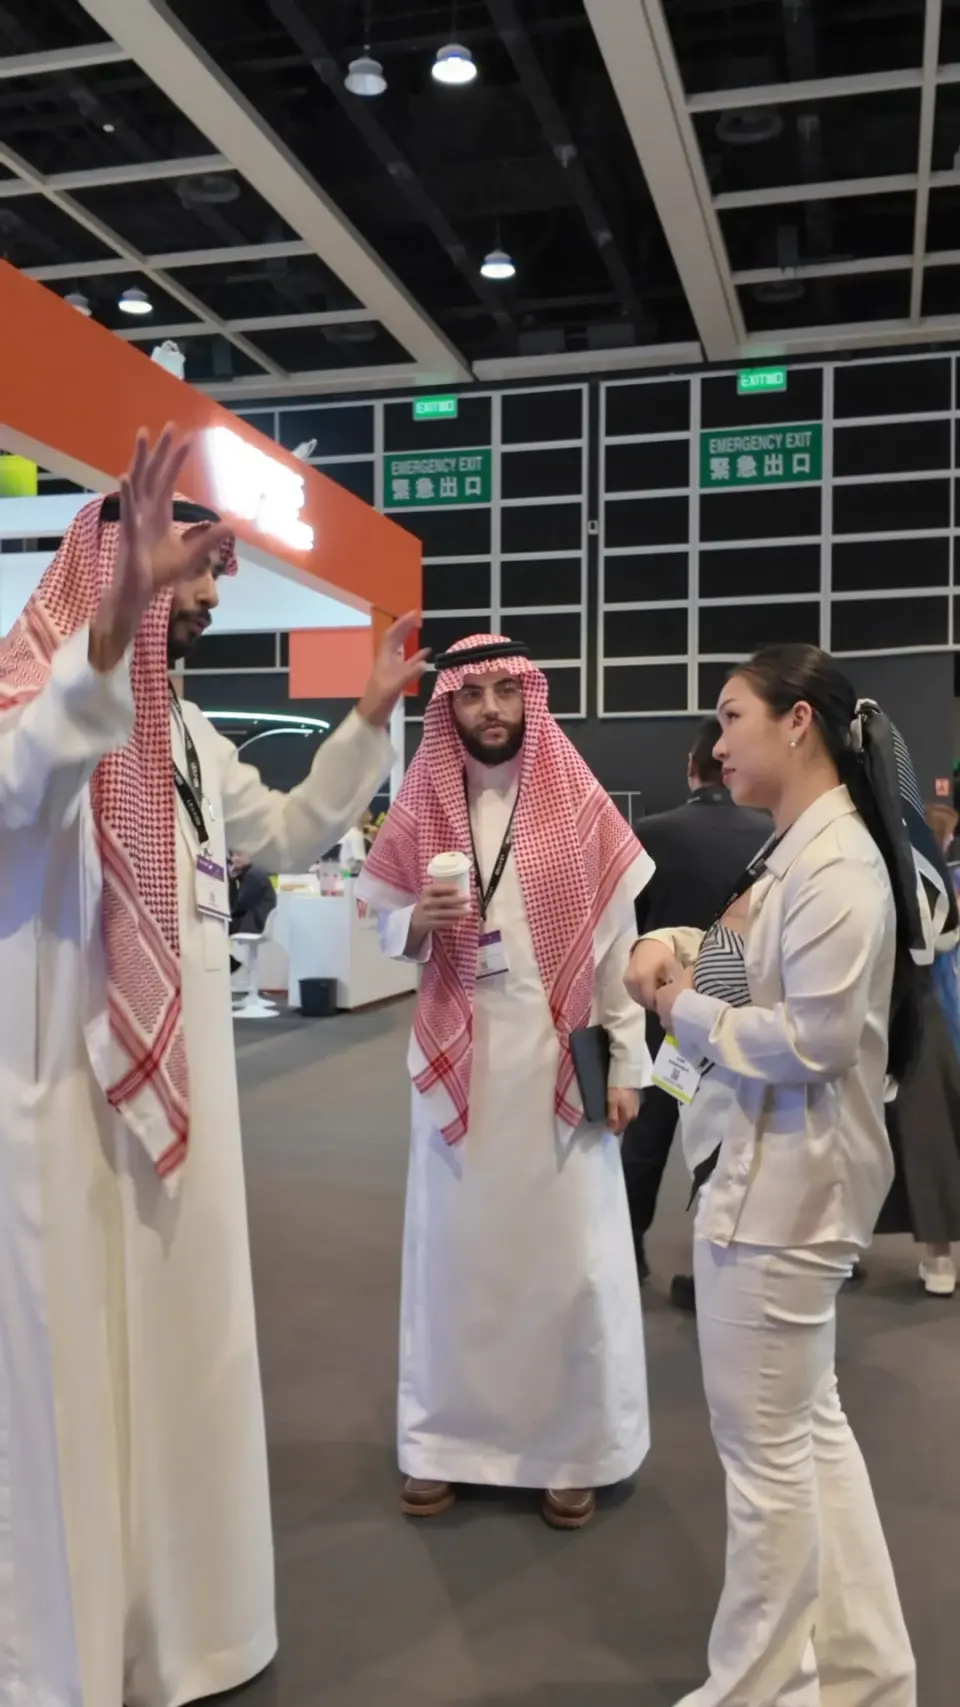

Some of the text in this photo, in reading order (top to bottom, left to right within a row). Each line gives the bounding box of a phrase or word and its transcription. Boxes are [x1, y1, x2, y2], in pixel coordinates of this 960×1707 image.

[709, 431, 813, 454] EMERGENCY EXIT
[391, 456, 483, 476] EMERGENCY EXIT
[709, 453, 811, 481] 緊急出口
[391, 476, 482, 501] 緊急出口
